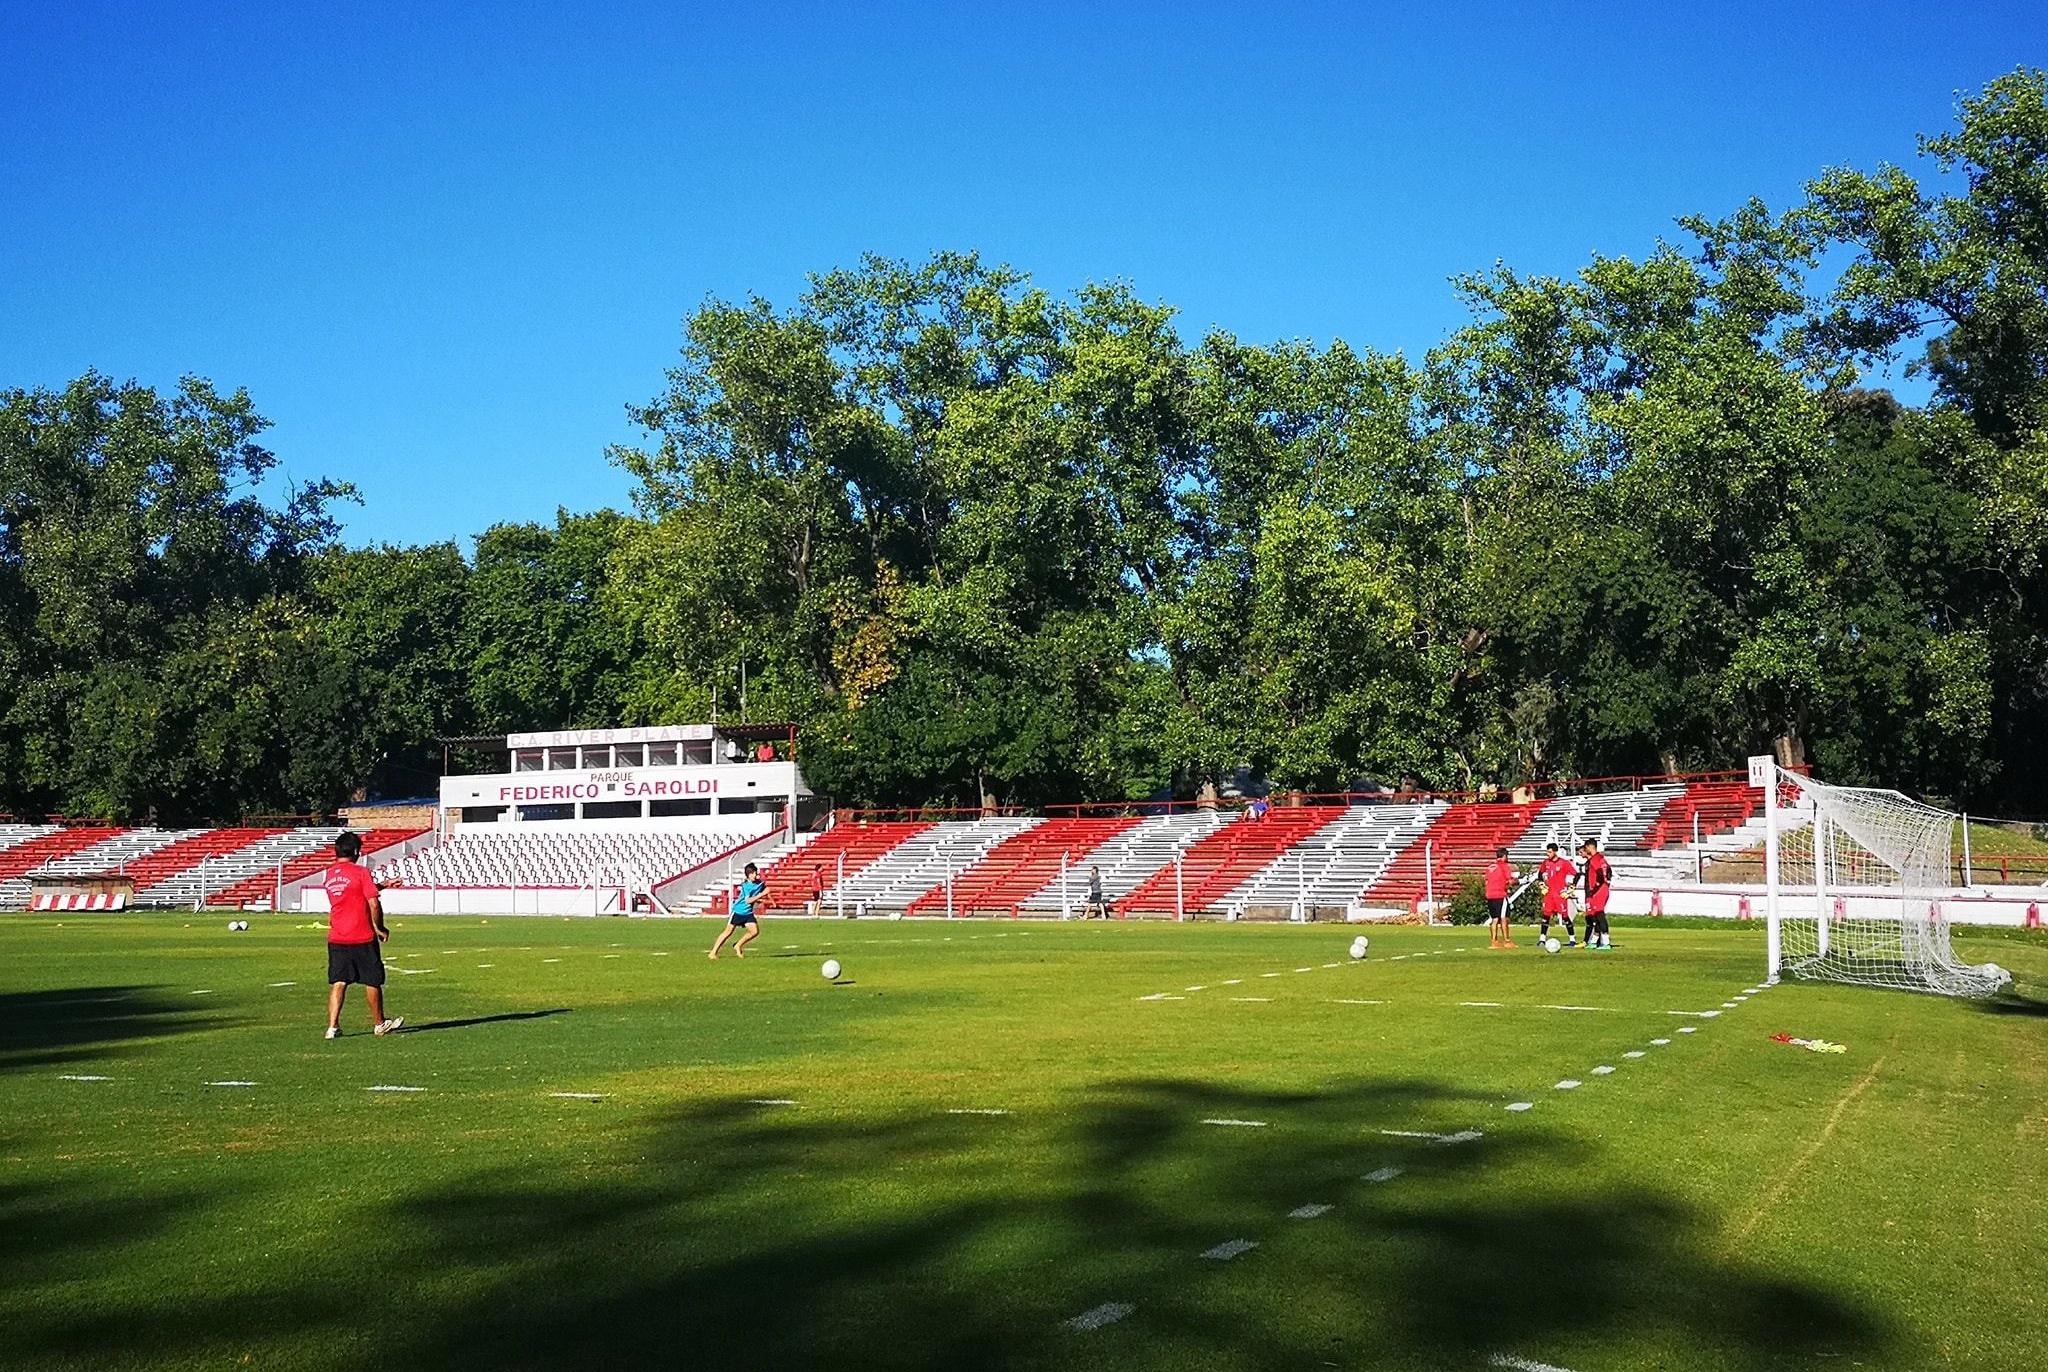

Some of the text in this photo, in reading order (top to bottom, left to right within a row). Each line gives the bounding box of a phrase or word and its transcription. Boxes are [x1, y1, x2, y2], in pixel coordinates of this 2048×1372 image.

[552, 731, 614, 745] RIVER
[630, 726, 703, 740] PLATE
[591, 772, 633, 783] PARQUE
[500, 779, 718, 801] FEDERICO SAROLDI
